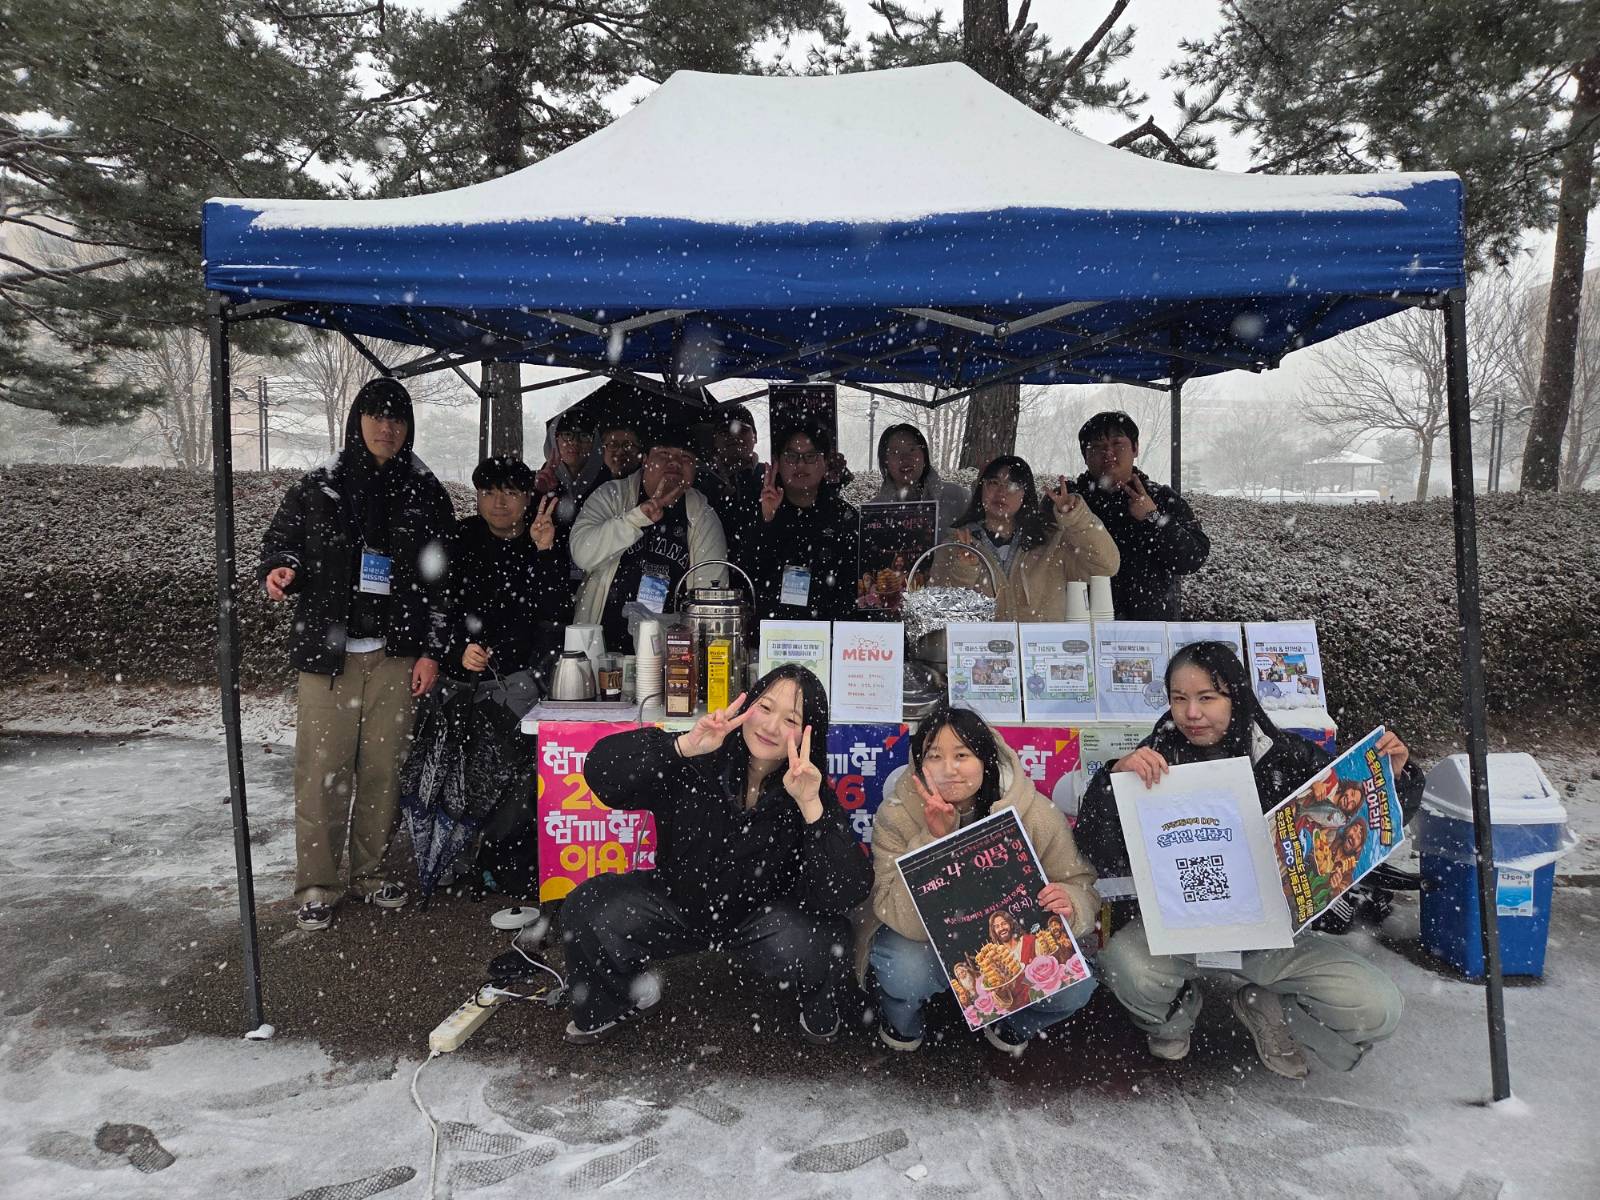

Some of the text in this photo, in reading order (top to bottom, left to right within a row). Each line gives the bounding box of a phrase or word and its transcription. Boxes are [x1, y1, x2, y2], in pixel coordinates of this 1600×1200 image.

[842, 649, 893, 661] MENU
[1157, 828, 1233, 848] 온라인 설문지
[973, 842, 1009, 869] 어묵
[1282, 840, 1295, 865] DFC
